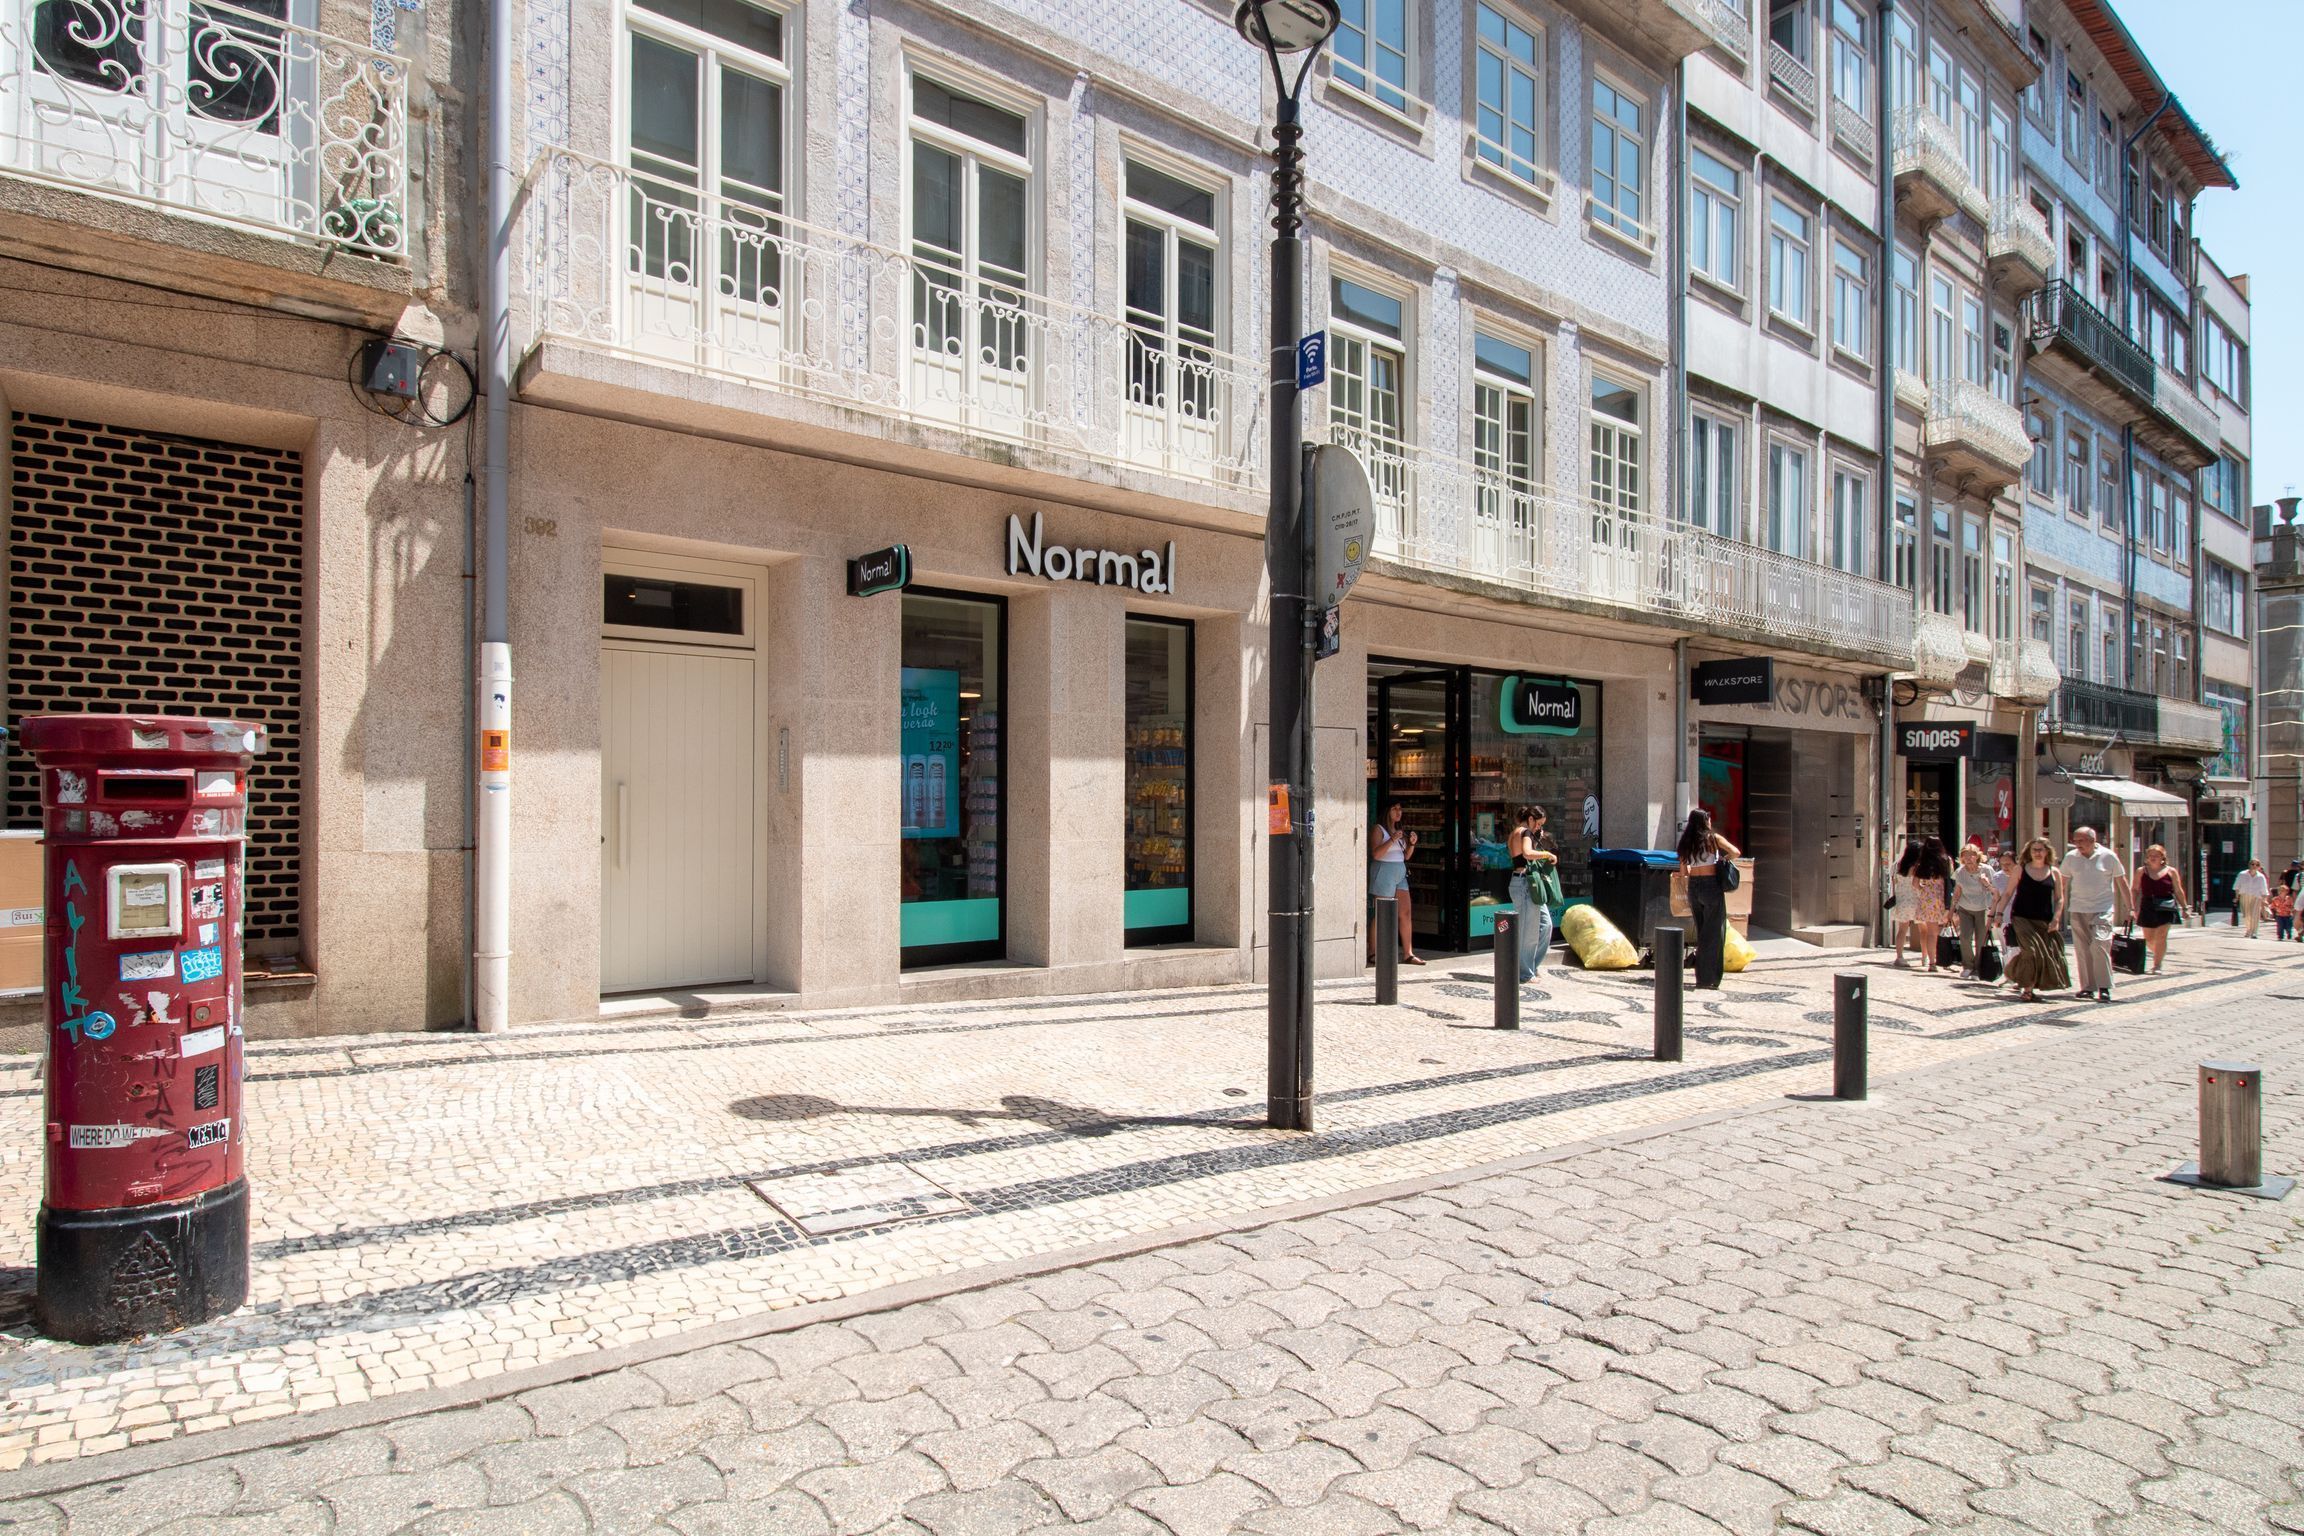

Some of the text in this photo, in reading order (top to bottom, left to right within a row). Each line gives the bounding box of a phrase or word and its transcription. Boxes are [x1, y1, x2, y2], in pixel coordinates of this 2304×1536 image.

[1007, 511, 1176, 595] Normal
[860, 555, 892, 583] Normal
[1704, 675, 1763, 687] WALKSTORE
[1528, 690, 1575, 718] Normal
[1906, 729, 1960, 751] snipes
[71, 1127, 103, 1146] WHERE
